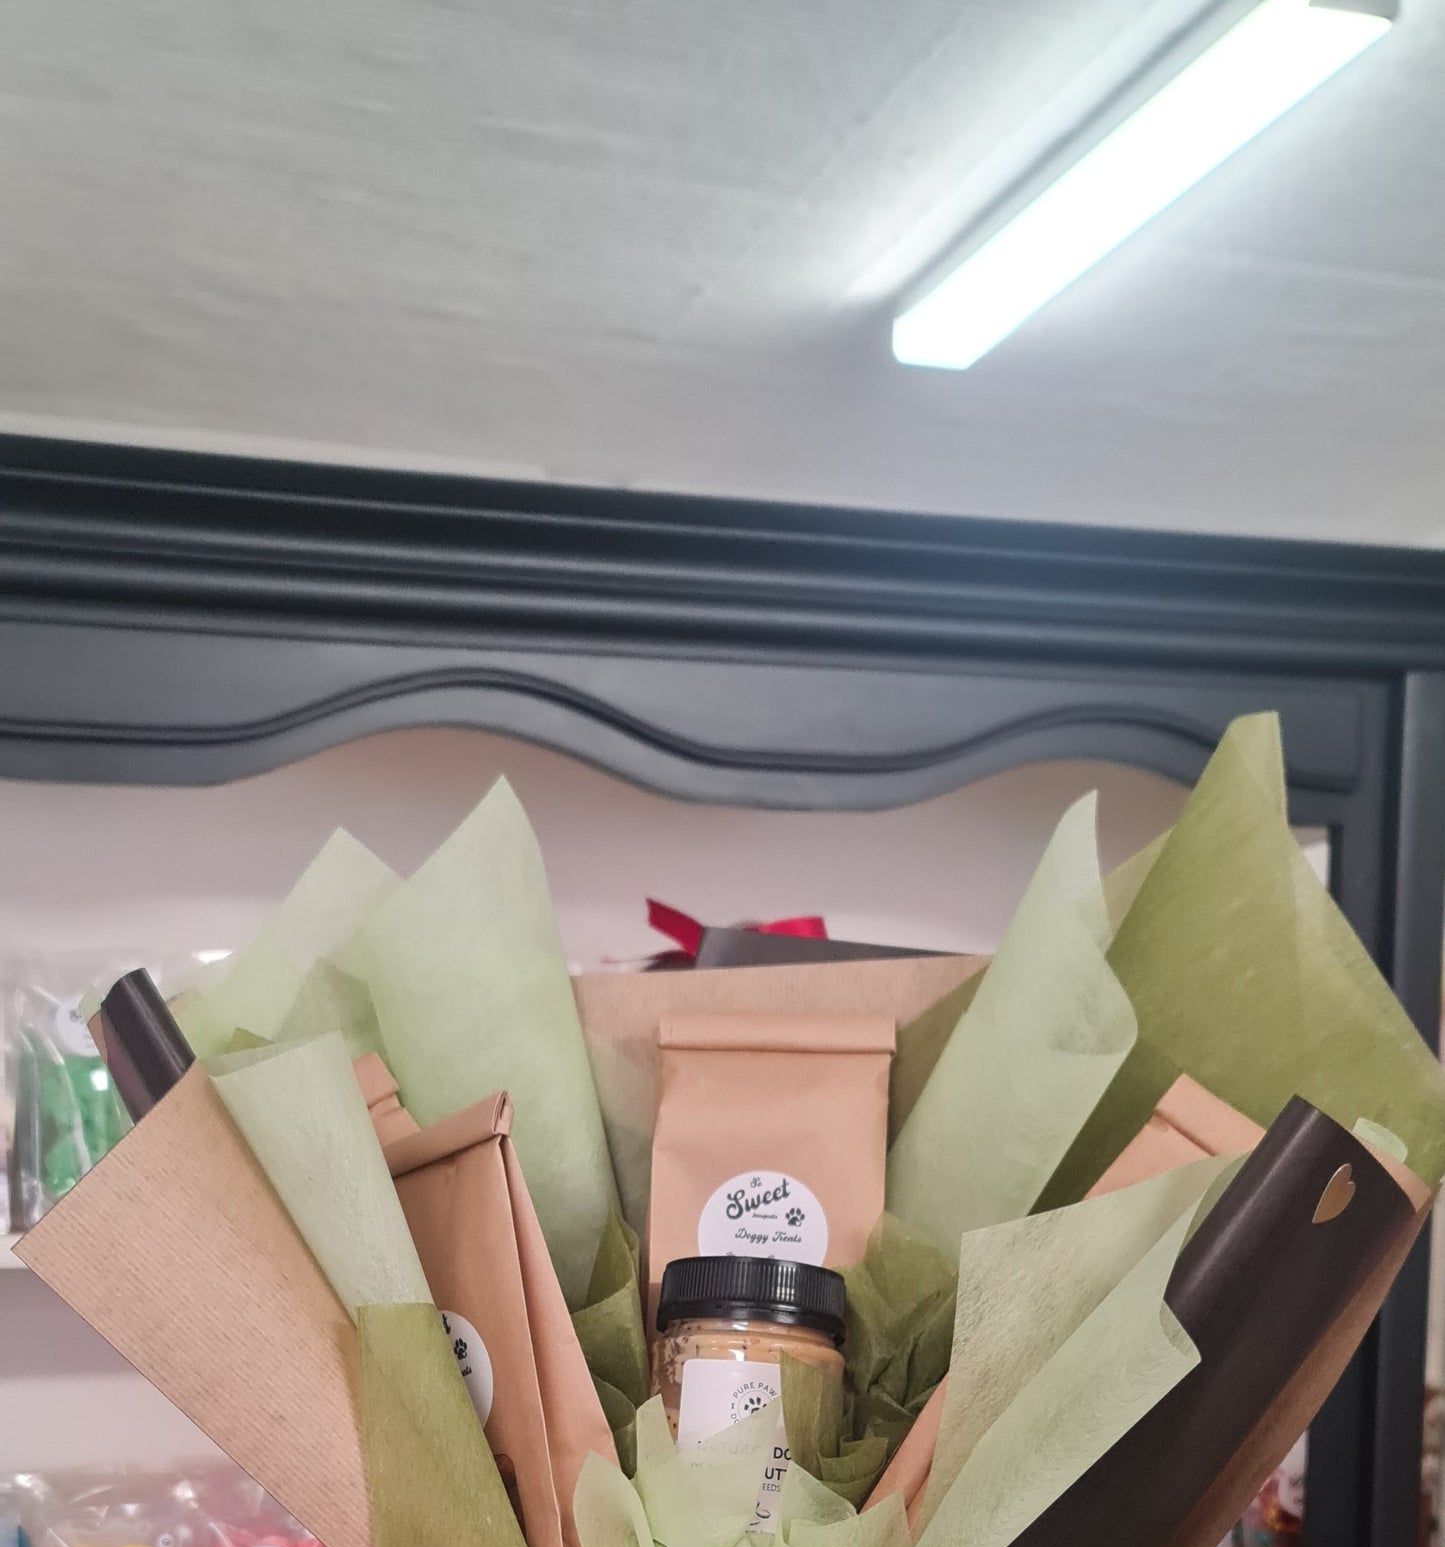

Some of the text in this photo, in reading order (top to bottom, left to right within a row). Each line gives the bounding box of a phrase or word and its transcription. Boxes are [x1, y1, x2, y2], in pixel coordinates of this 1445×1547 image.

[726, 1178, 790, 1219] Sweet
[735, 1228, 802, 1244] Doggy Treats
[732, 1382, 755, 1399] PURE
[762, 1483, 782, 1492] EEDS
